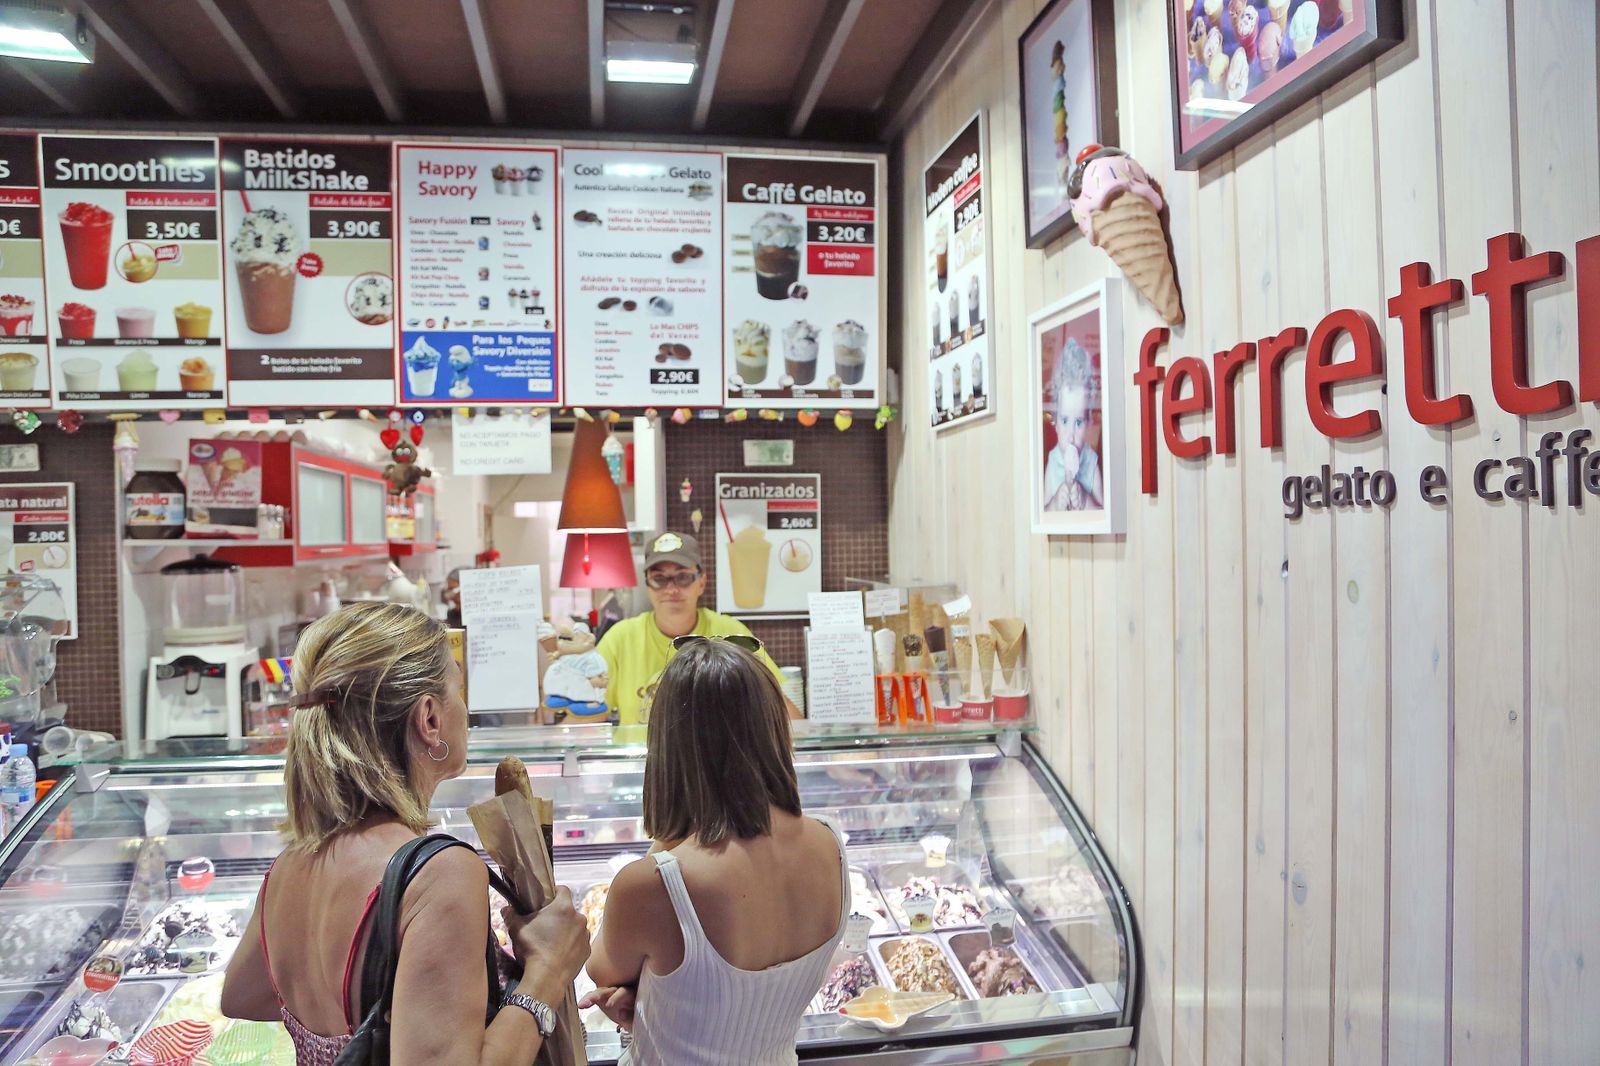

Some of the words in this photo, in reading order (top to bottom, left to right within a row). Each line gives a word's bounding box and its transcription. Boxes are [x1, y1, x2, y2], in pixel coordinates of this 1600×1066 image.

[244, 148, 336, 169] Batidos
[55, 158, 206, 183] Smoothies
[418, 160, 478, 179] Happy
[574, 164, 603, 176] Cool
[669, 166, 712, 179] Gelato
[953, 152, 977, 186] coffee
[245, 169, 369, 190] MilkShake
[418, 182, 478, 200] Savory
[742, 182, 796, 204] Caffé
[800, 185, 866, 205] Gelato
[408, 216, 438, 226] Savory
[496, 218, 526, 227] Savory
[957, 198, 979, 230] 2,90€
[146, 222, 201, 240] 3,50€
[328, 221, 380, 238] 3,90€
[818, 225, 866, 243] 3,20€
[824, 259, 855, 268] favorito
[835, 252, 860, 260] helado
[472, 335, 494, 345] Para
[499, 335, 513, 345] los
[517, 335, 551, 346] Peques
[260, 355, 270, 365] 2
[473, 346, 506, 358] Savory
[657, 371, 694, 384] 2,90€
[719, 482, 814, 498] Granizados
[1282, 464, 1396, 520] gelato
[1420, 464, 1448, 503] e
[21, 496, 67, 508] natural
